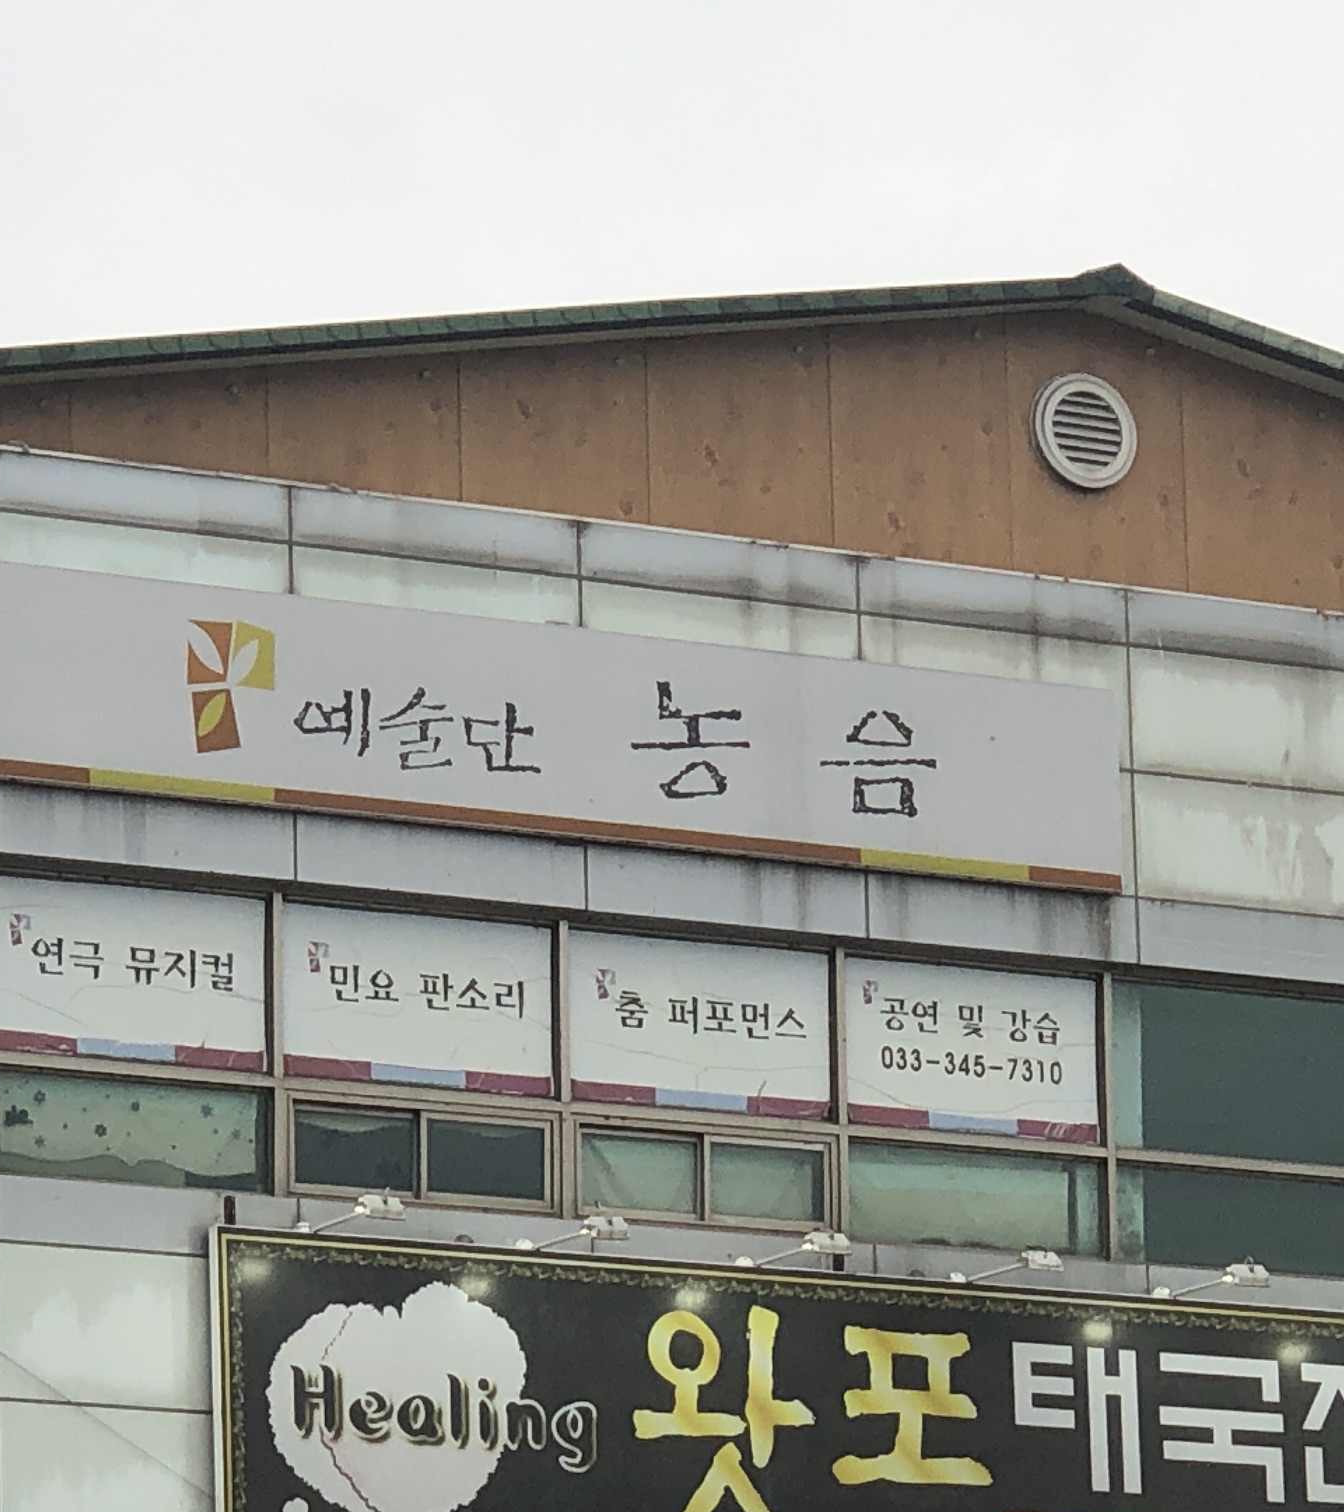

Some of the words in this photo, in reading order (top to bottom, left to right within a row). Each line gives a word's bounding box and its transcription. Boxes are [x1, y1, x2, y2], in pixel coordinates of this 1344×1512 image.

[293, 686, 542, 774] 예술단
[31, 936, 104, 980] 연극
[125, 945, 234, 992] 뮤지컬
[329, 964, 400, 1003] 민요
[419, 972, 525, 1019] 판소리
[615, 989, 649, 1029] 춤
[667, 996, 808, 1040] 퍼포먼스
[880, 997, 939, 1034] 공연
[958, 1004, 984, 1038] 및
[1001, 1009, 1061, 1046] 강습
[881, 1045, 1063, 1086] 033-345-7310
[290, 1362, 598, 1474] Healing
